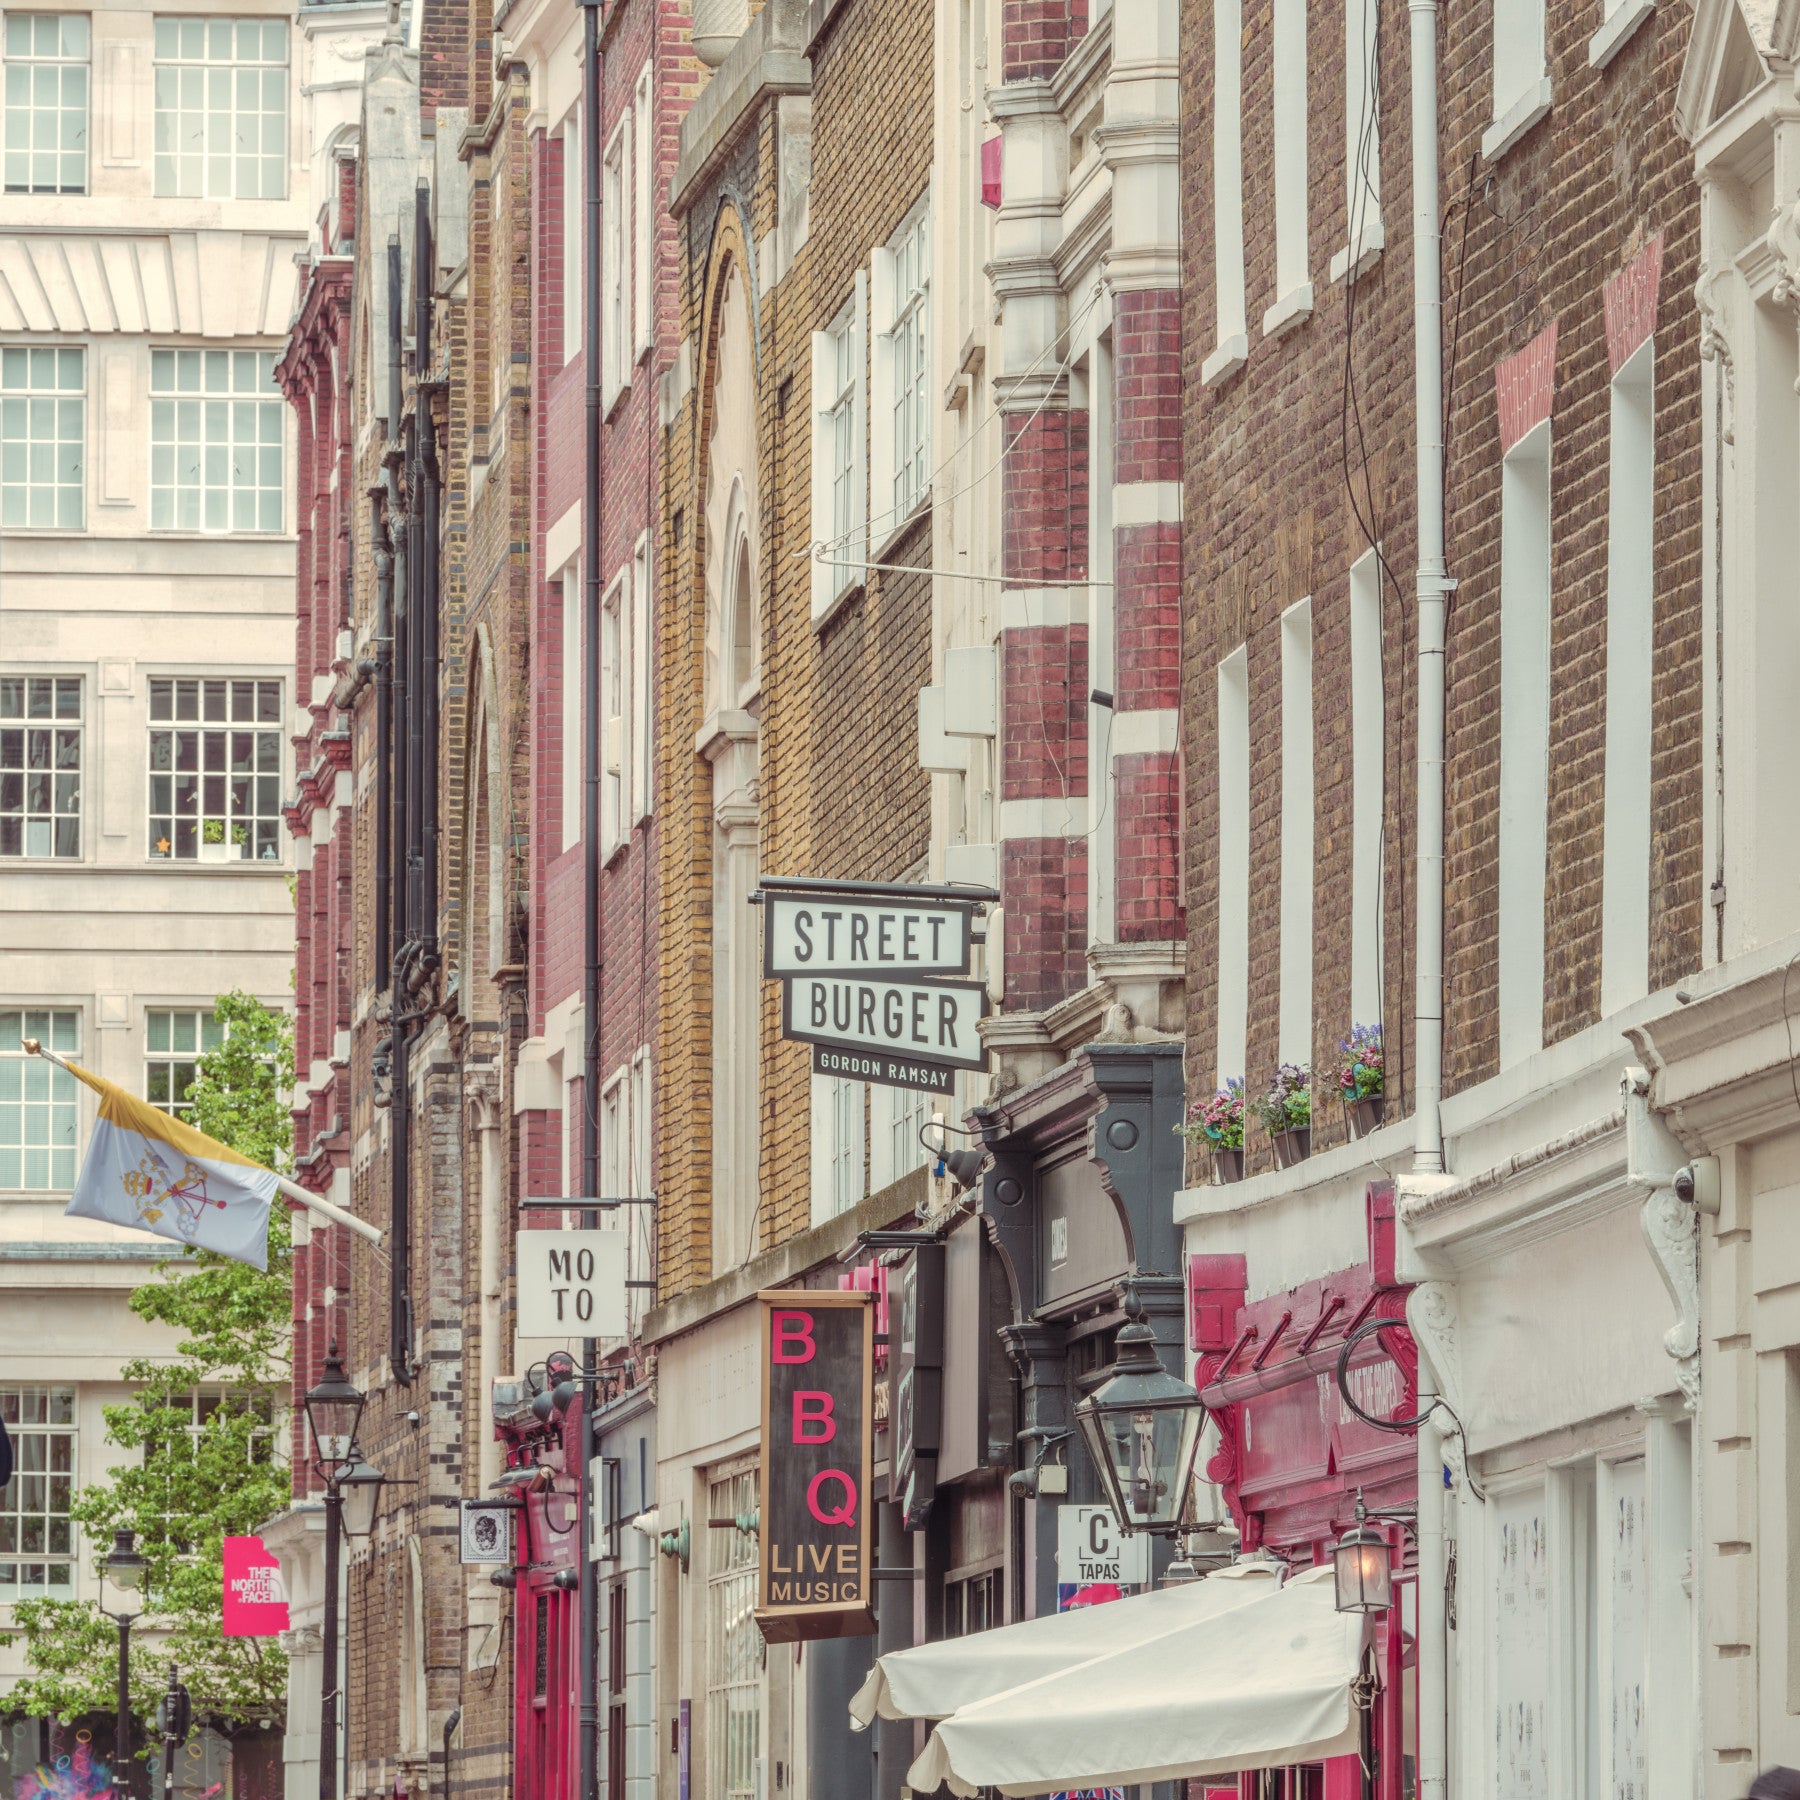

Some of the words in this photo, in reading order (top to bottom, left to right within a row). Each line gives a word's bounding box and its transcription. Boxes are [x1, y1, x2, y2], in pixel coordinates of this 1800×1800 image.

[794, 910, 946, 963] STREET
[811, 982, 959, 1049] BURGER
[821, 1053, 881, 1077] GORDON
[888, 1063, 948, 1088] RAMSAY
[549, 1248, 594, 1282] MO
[551, 1288, 593, 1321] TO
[1089, 1513, 1109, 1555] C
[248, 1566, 270, 1579] THE
[772, 1544, 858, 1574] LIVE
[1079, 1563, 1120, 1580] TAPAS
[231, 1579, 270, 1592] NORTH
[241, 1591, 270, 1604] FACE
[772, 1582, 858, 1602] MUSIC
